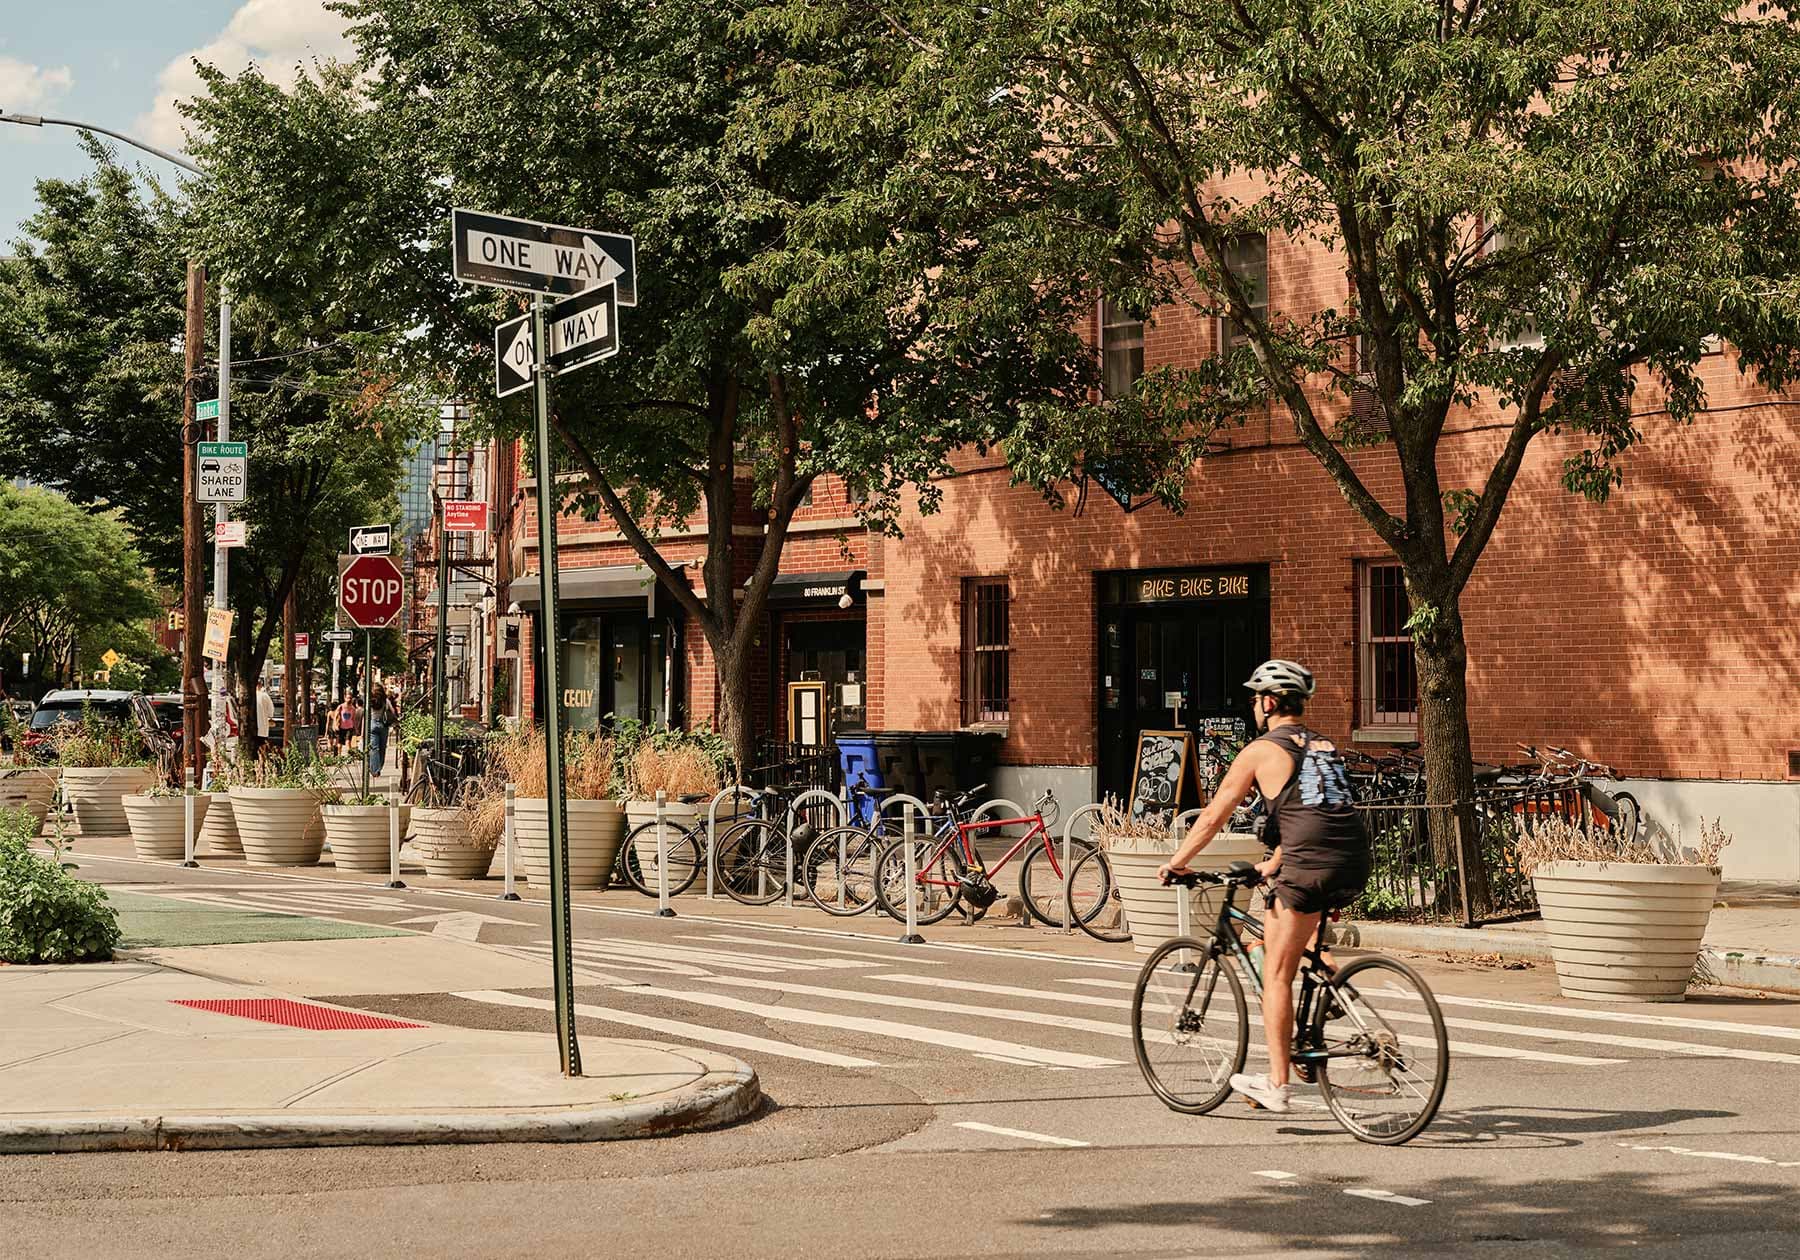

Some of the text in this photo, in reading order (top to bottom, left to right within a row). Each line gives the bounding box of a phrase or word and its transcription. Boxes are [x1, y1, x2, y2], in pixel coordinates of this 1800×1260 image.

[482, 236, 606, 279] ONE WAY
[563, 310, 599, 346] WAY
[515, 338, 533, 366] ON
[202, 446, 243, 454] BIKE ROUTE
[201, 476, 242, 486] SHARED
[208, 488, 235, 497] LANE
[446, 511, 469, 519] Anytime
[356, 535, 385, 547] ONE WAY
[345, 578, 400, 605] STOP
[804, 586, 846, 597] 80 FRANKLIN ST
[1143, 576, 1249, 598] BIKE BIKE BIKE
[563, 688, 594, 708] CECILY
